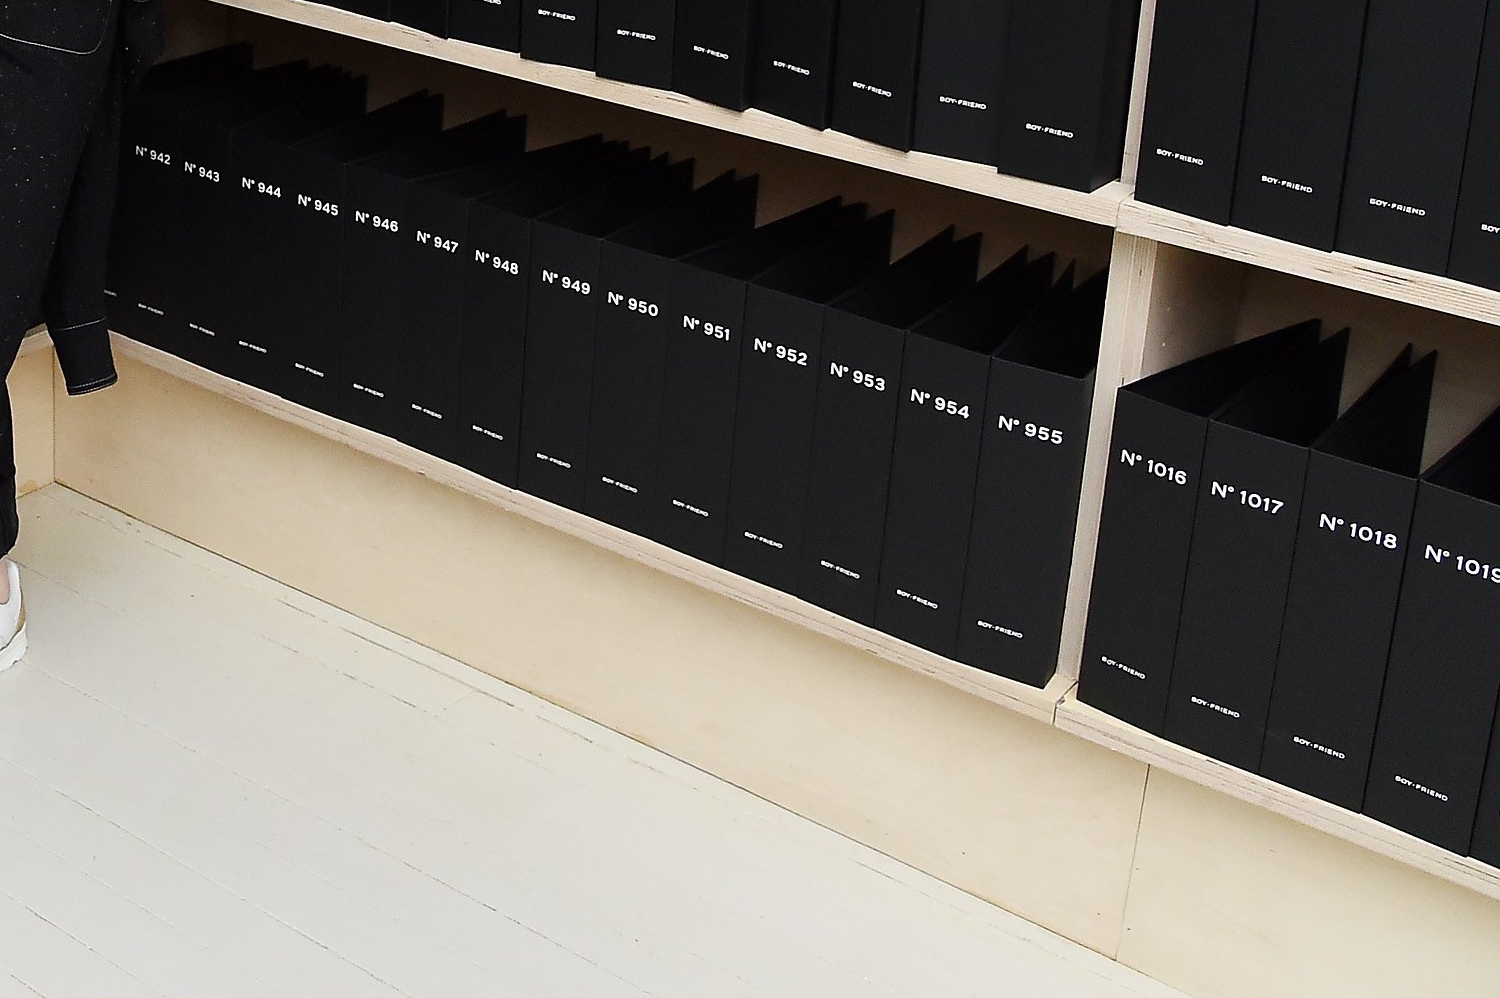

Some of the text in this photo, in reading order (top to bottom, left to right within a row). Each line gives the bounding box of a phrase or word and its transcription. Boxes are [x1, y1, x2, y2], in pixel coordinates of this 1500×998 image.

[257, 181, 282, 198] 944
[492, 256, 519, 275] 948
[627, 297, 659, 317] 950
[775, 345, 808, 367] 952
[852, 370, 886, 392] 953
[934, 396, 970, 419] 954
[1024, 423, 1063, 445] 955
[1147, 459, 1187, 485] 1016
[1239, 490, 1284, 514] 1017
[1349, 522, 1397, 549] 1018
